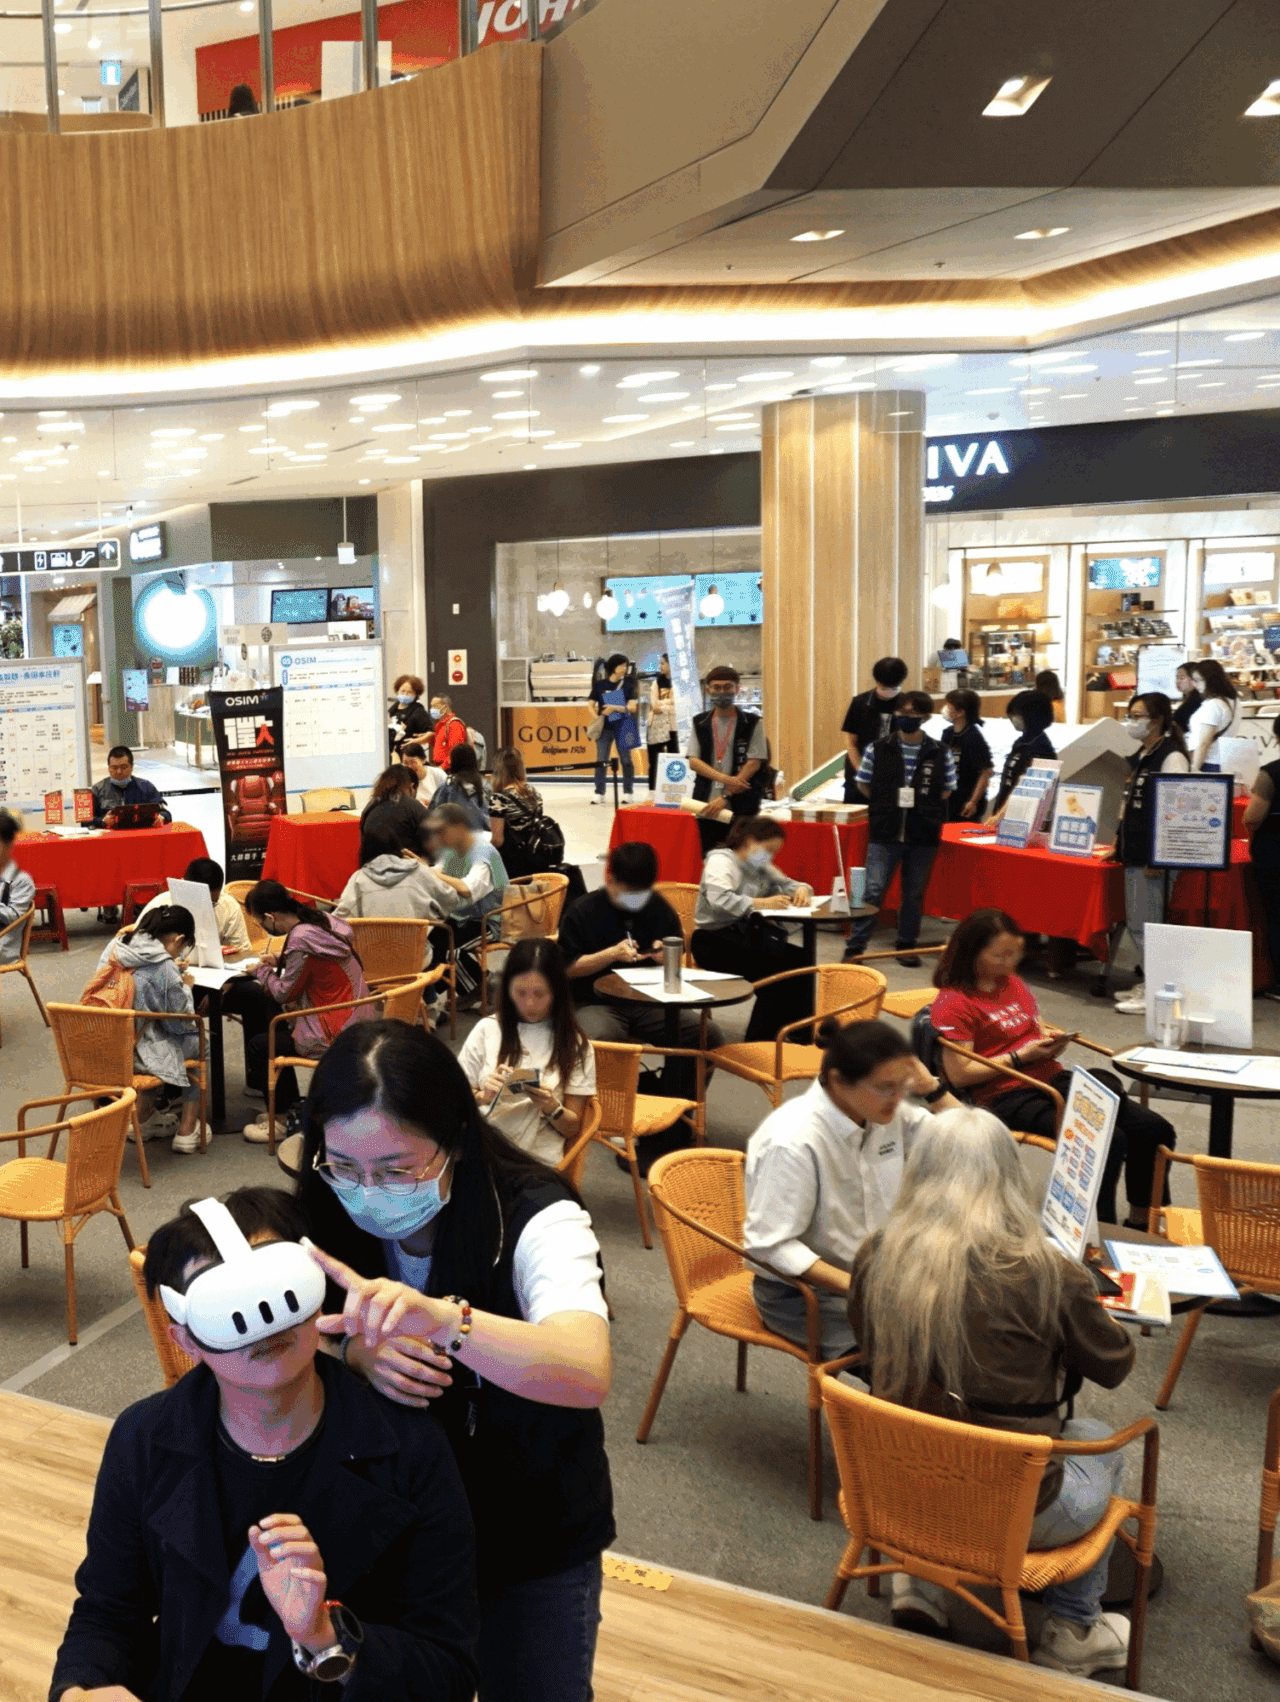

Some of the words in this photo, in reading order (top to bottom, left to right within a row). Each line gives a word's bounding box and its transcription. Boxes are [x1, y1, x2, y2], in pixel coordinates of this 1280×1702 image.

[927, 440, 1009, 479] IVA
[294, 656, 317, 665] OSIM
[225, 695, 260, 707] OSIM
[542, 745, 569, 756] Belgium
